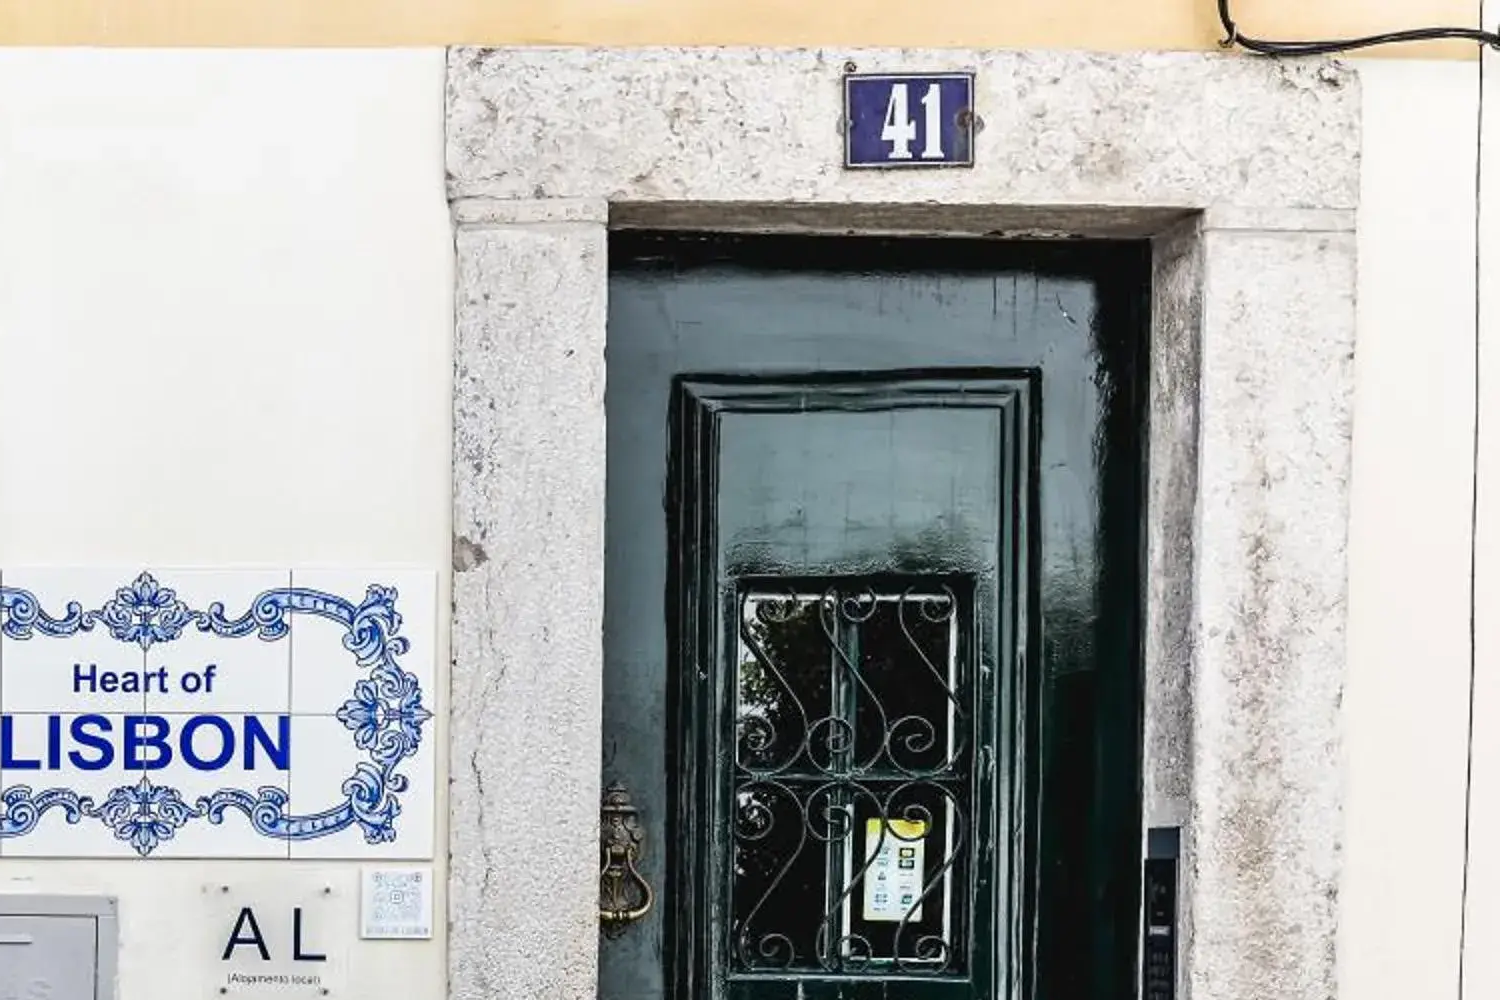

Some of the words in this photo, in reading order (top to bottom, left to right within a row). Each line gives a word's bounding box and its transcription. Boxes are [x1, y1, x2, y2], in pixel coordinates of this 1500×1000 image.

[881, 83, 944, 158] 41
[73, 664, 168, 693] Heart
[181, 664, 217, 693] of
[0, 713, 290, 771] LISBON
